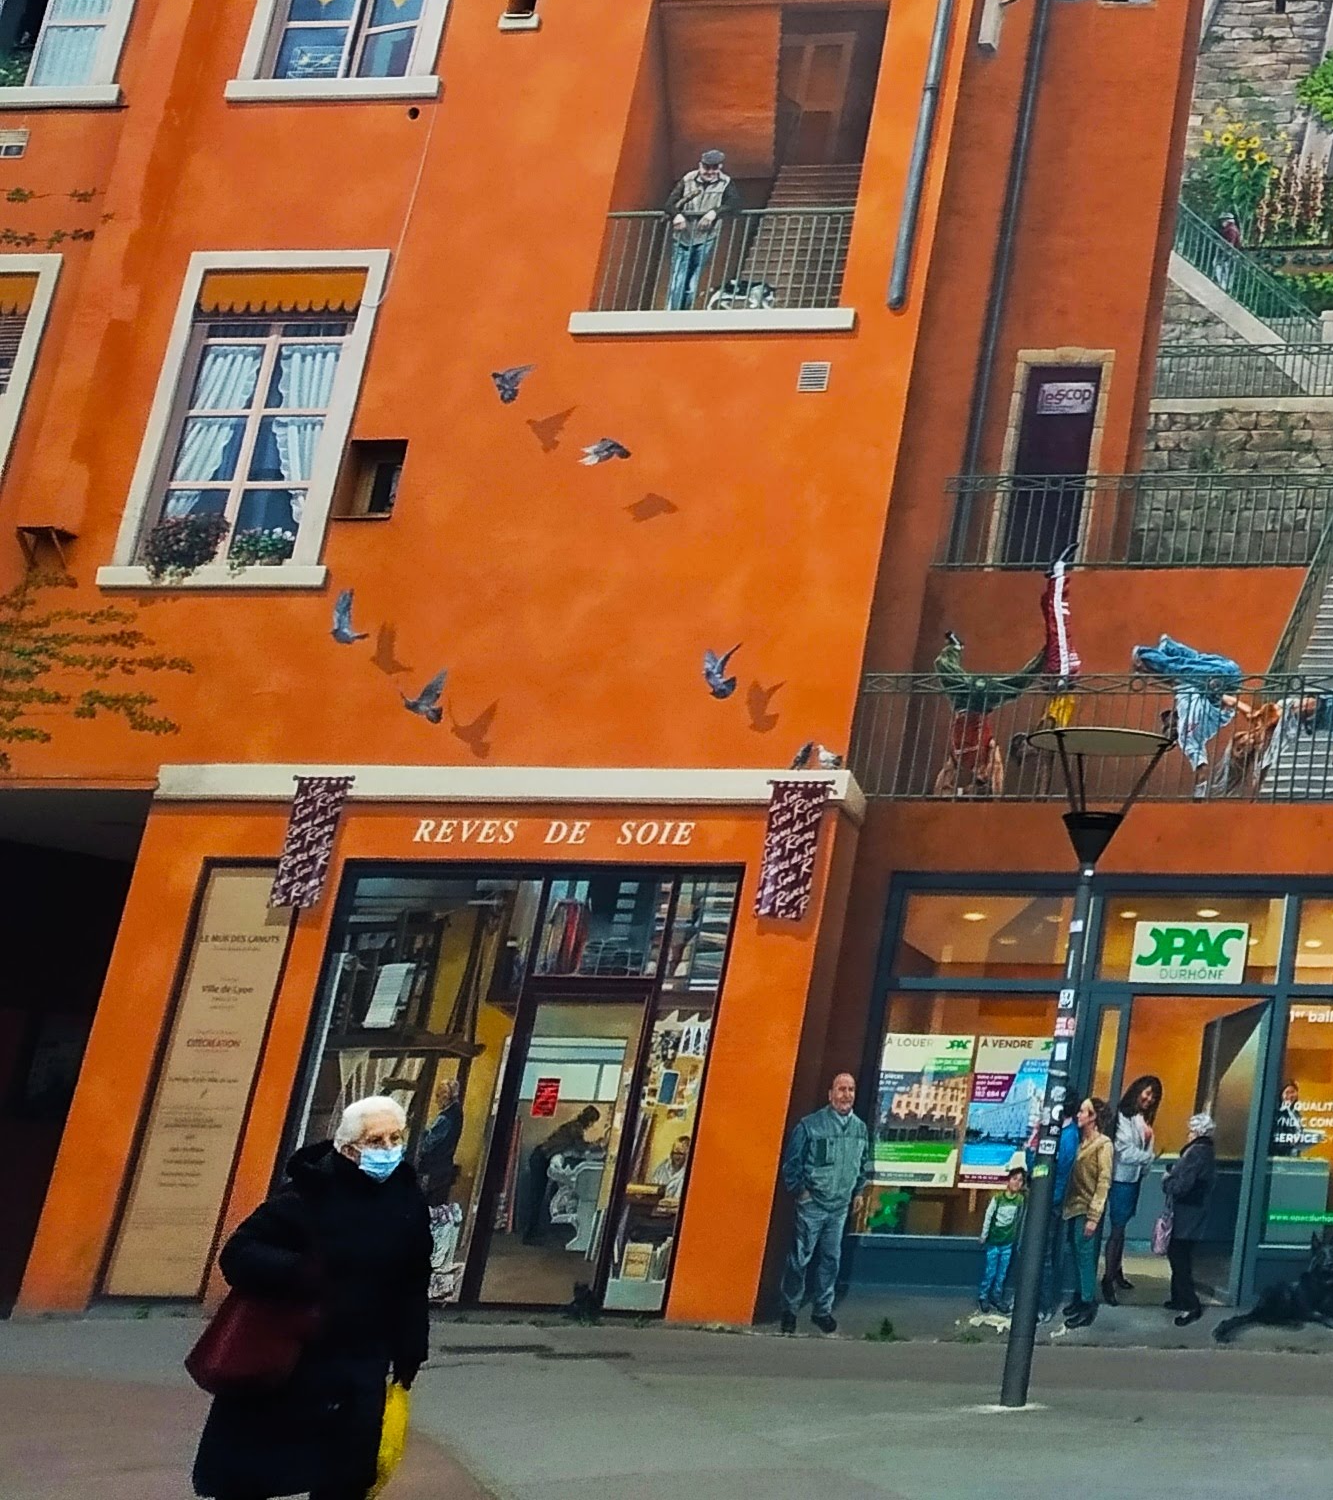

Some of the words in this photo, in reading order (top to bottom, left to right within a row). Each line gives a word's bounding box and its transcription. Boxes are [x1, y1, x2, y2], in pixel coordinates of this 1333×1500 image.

[412, 819, 518, 843] REVES
[543, 821, 591, 844] DE
[616, 821, 695, 845] SOIE
[993, 1040, 1034, 1049] VENDRE
